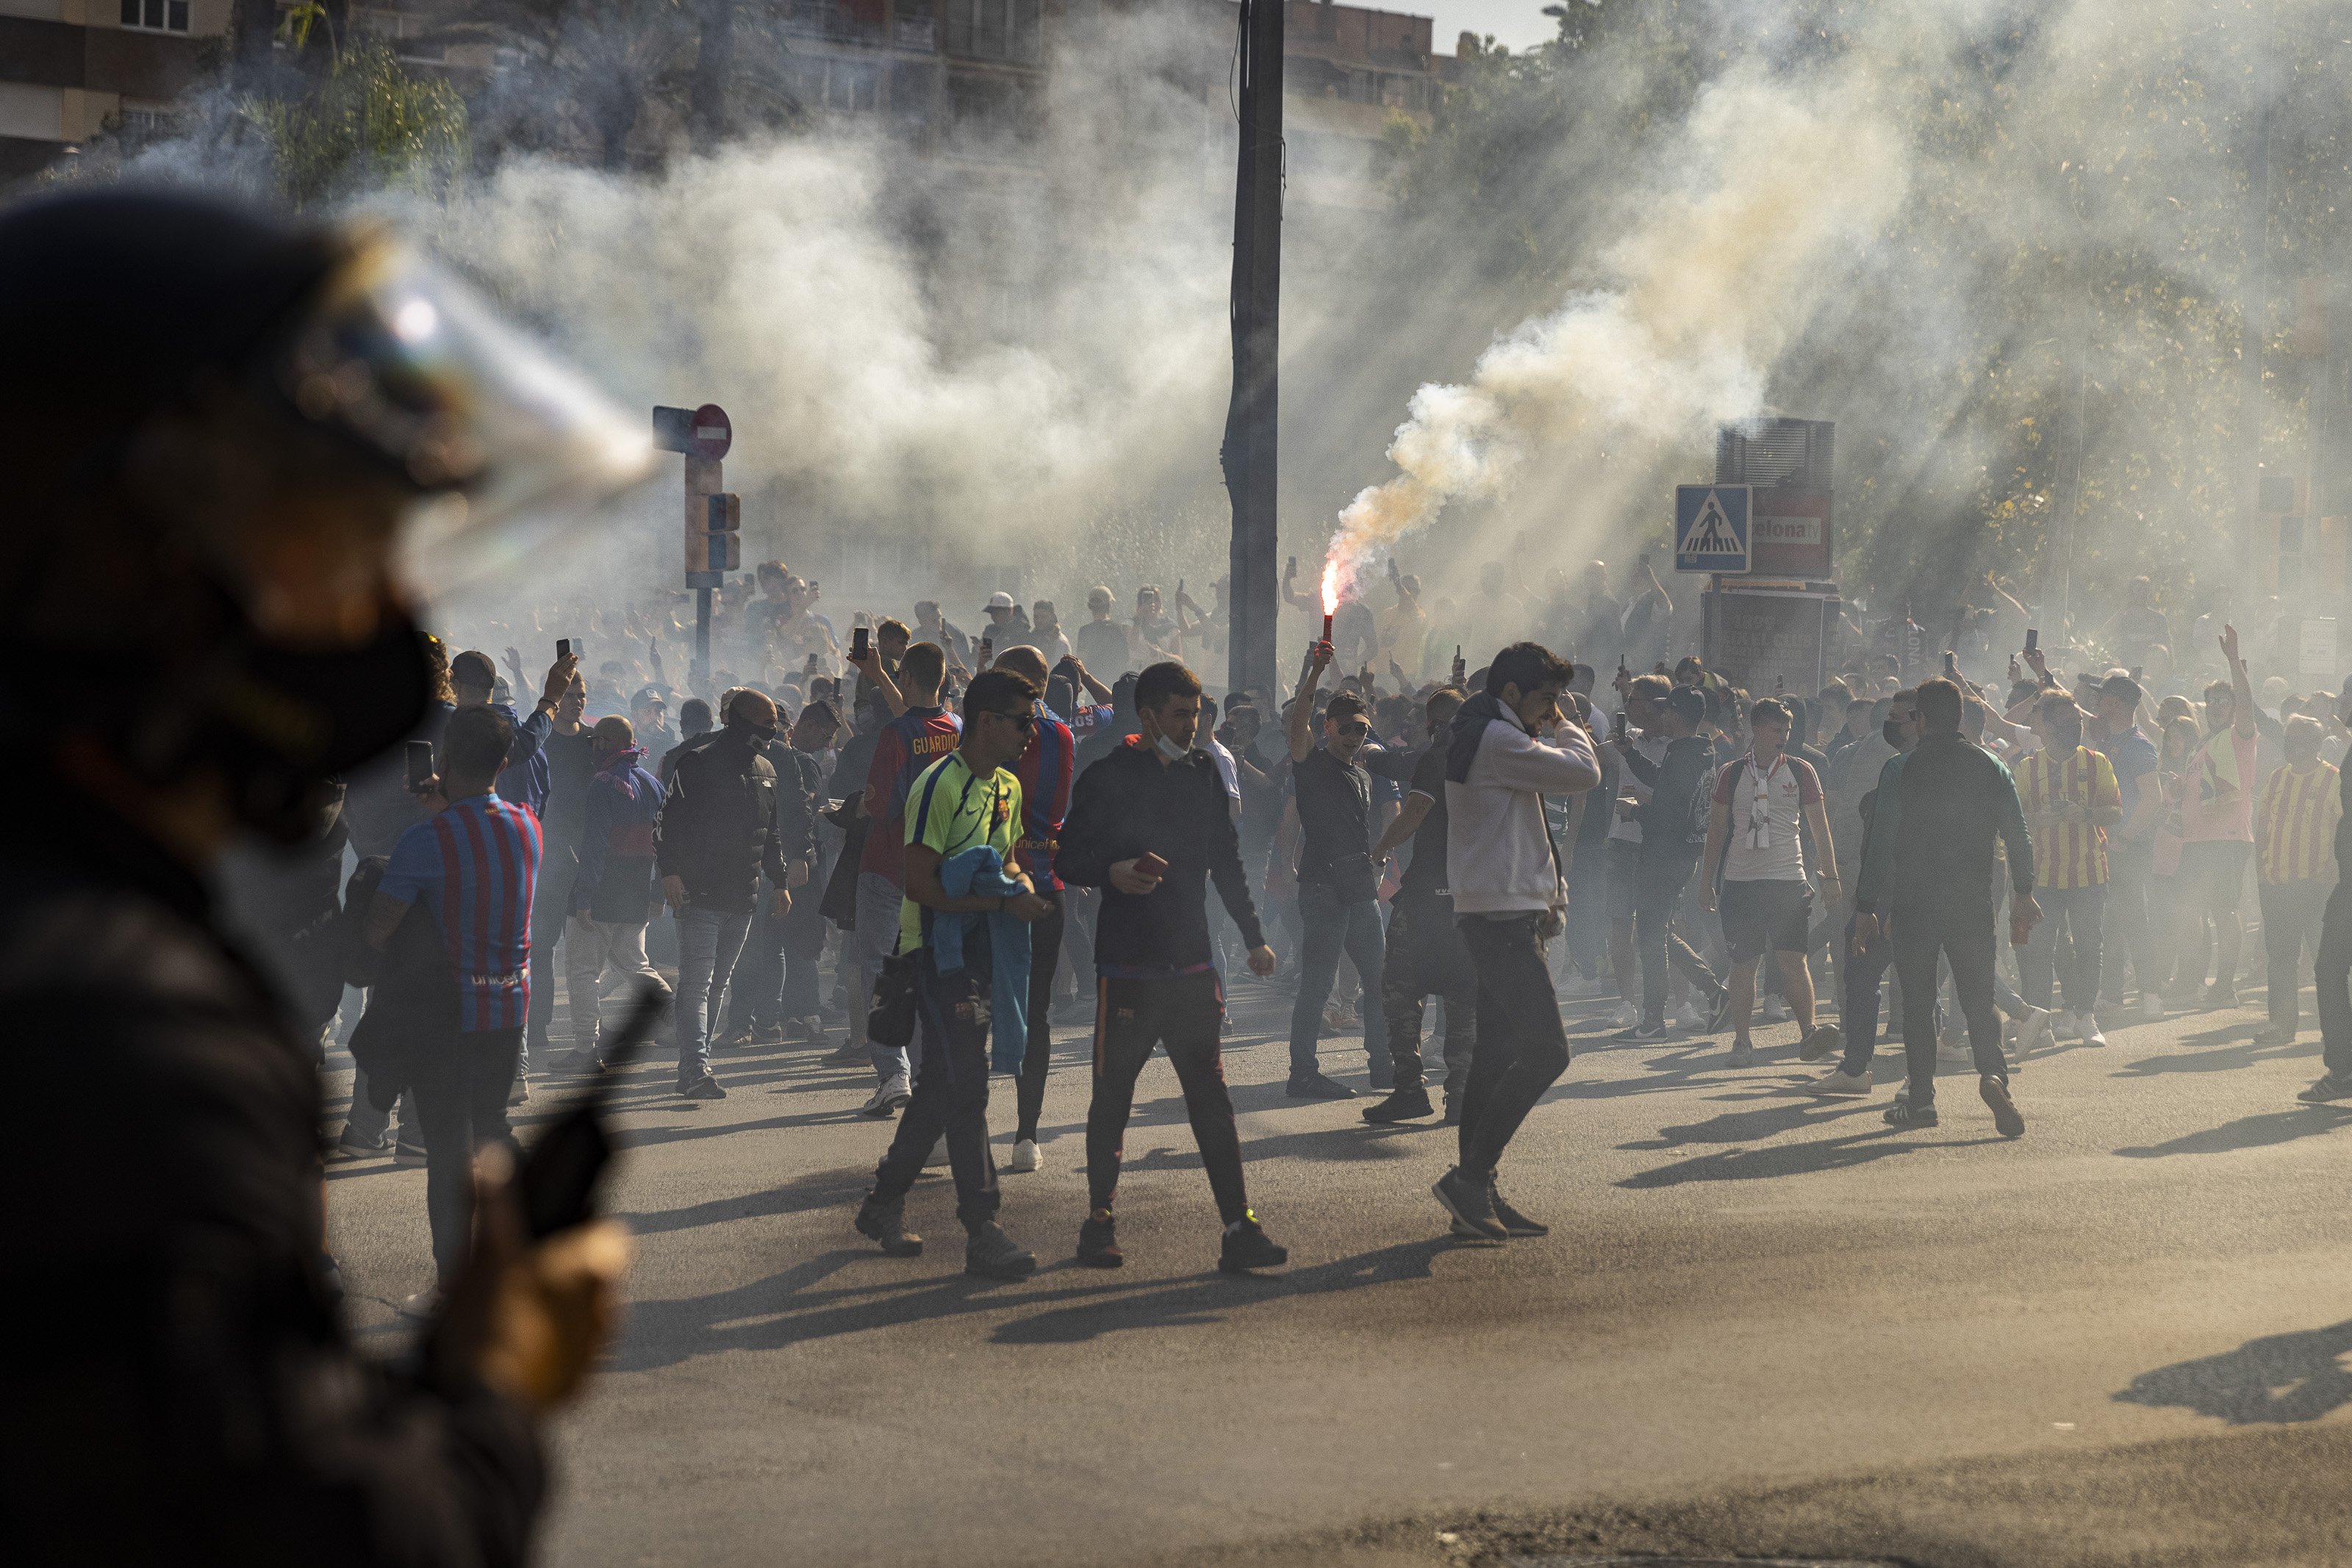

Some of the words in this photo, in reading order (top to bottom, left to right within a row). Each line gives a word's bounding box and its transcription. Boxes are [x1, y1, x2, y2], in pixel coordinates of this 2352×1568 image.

[1752, 519, 1805, 537] elona
[1072, 714, 1094, 728] OS
[913, 732, 959, 755] GUARDIO
[1015, 837, 1050, 850] unicef
[471, 971, 518, 986] unicef
